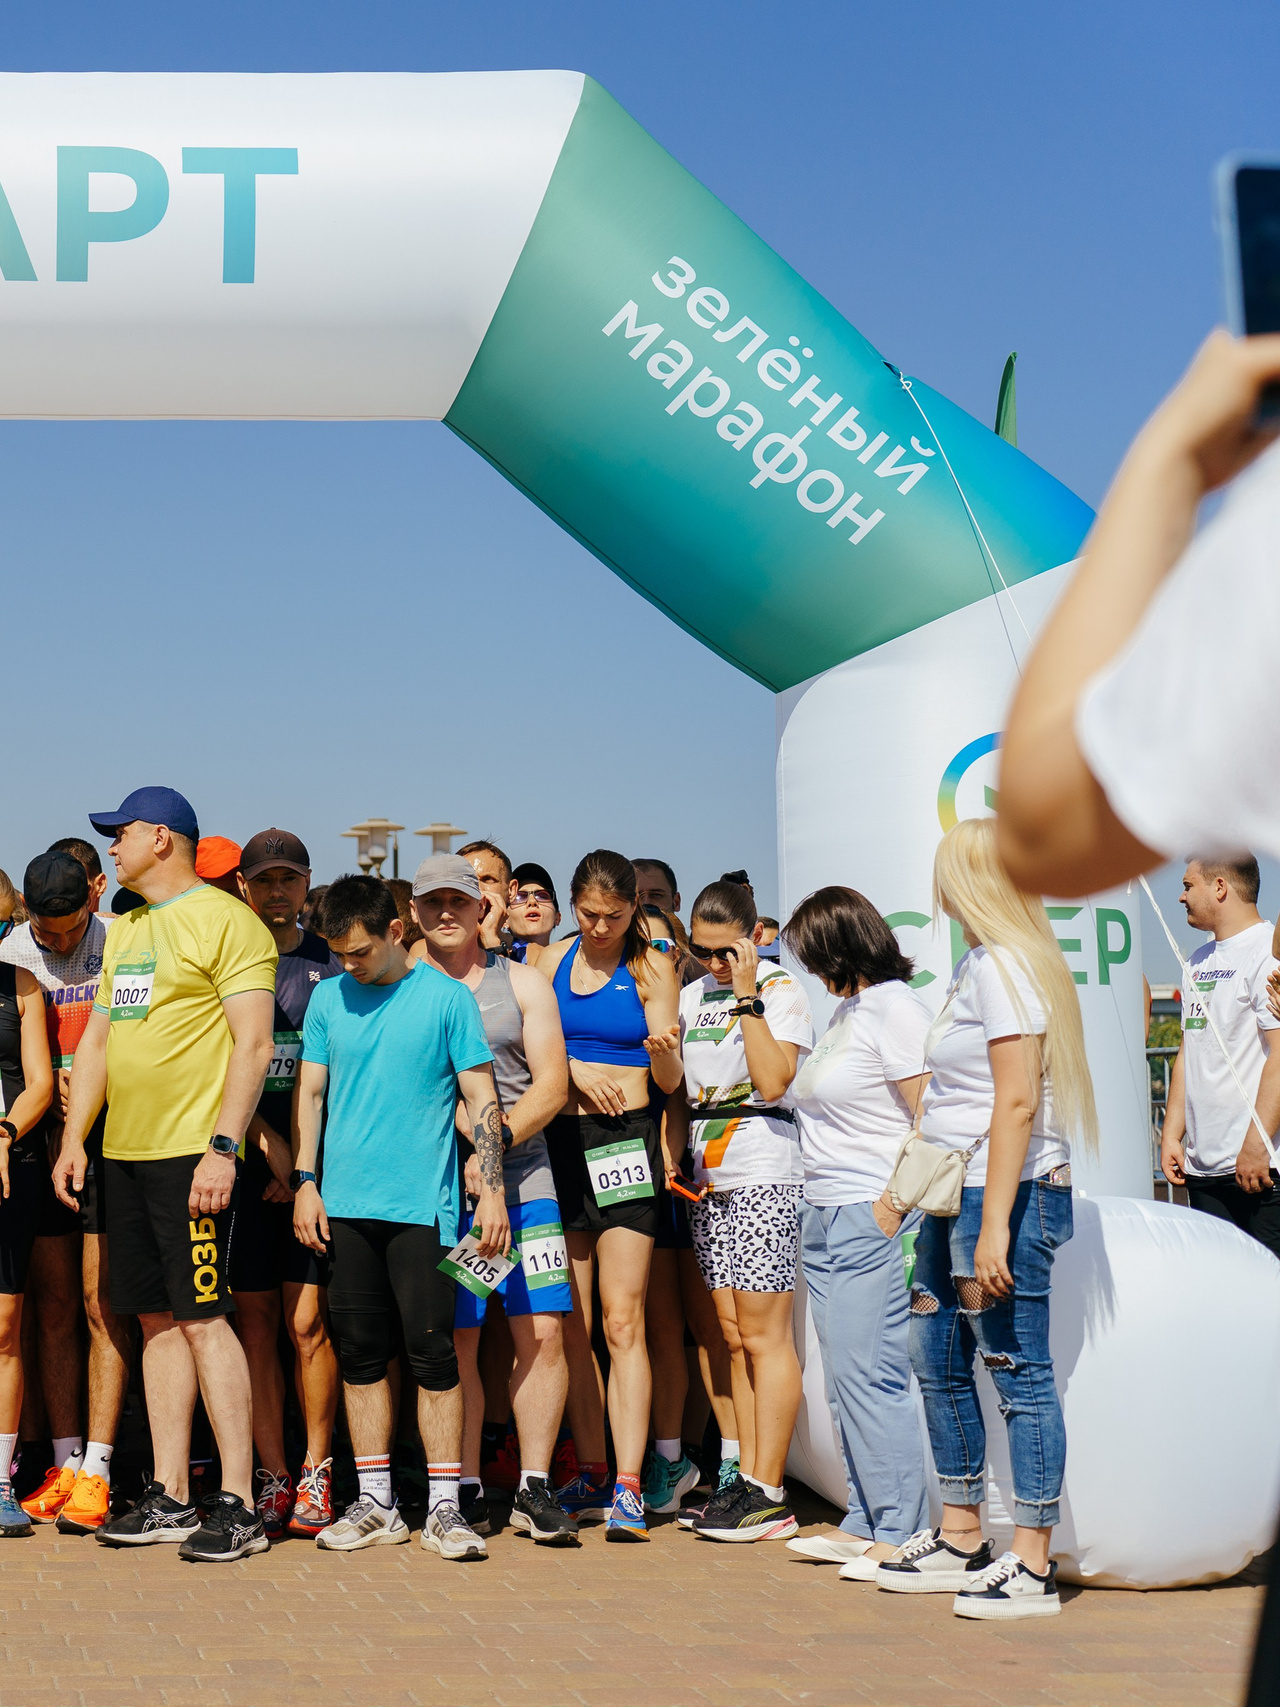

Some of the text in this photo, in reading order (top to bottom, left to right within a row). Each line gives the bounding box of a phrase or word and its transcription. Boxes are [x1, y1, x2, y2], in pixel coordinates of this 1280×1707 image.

[651, 255, 936, 496] зелёный
[601, 299, 886, 546] марафон
[43, 985, 101, 1007] РОВСК
[115, 988, 149, 1005] 0007
[695, 1011, 728, 1028] 1847
[267, 1057, 295, 1075] 79
[598, 1165, 645, 1190] 0313
[189, 1217, 219, 1303] ЮЗБ
[455, 1248, 500, 1283] 1405
[529, 1249, 568, 1272] 1161
